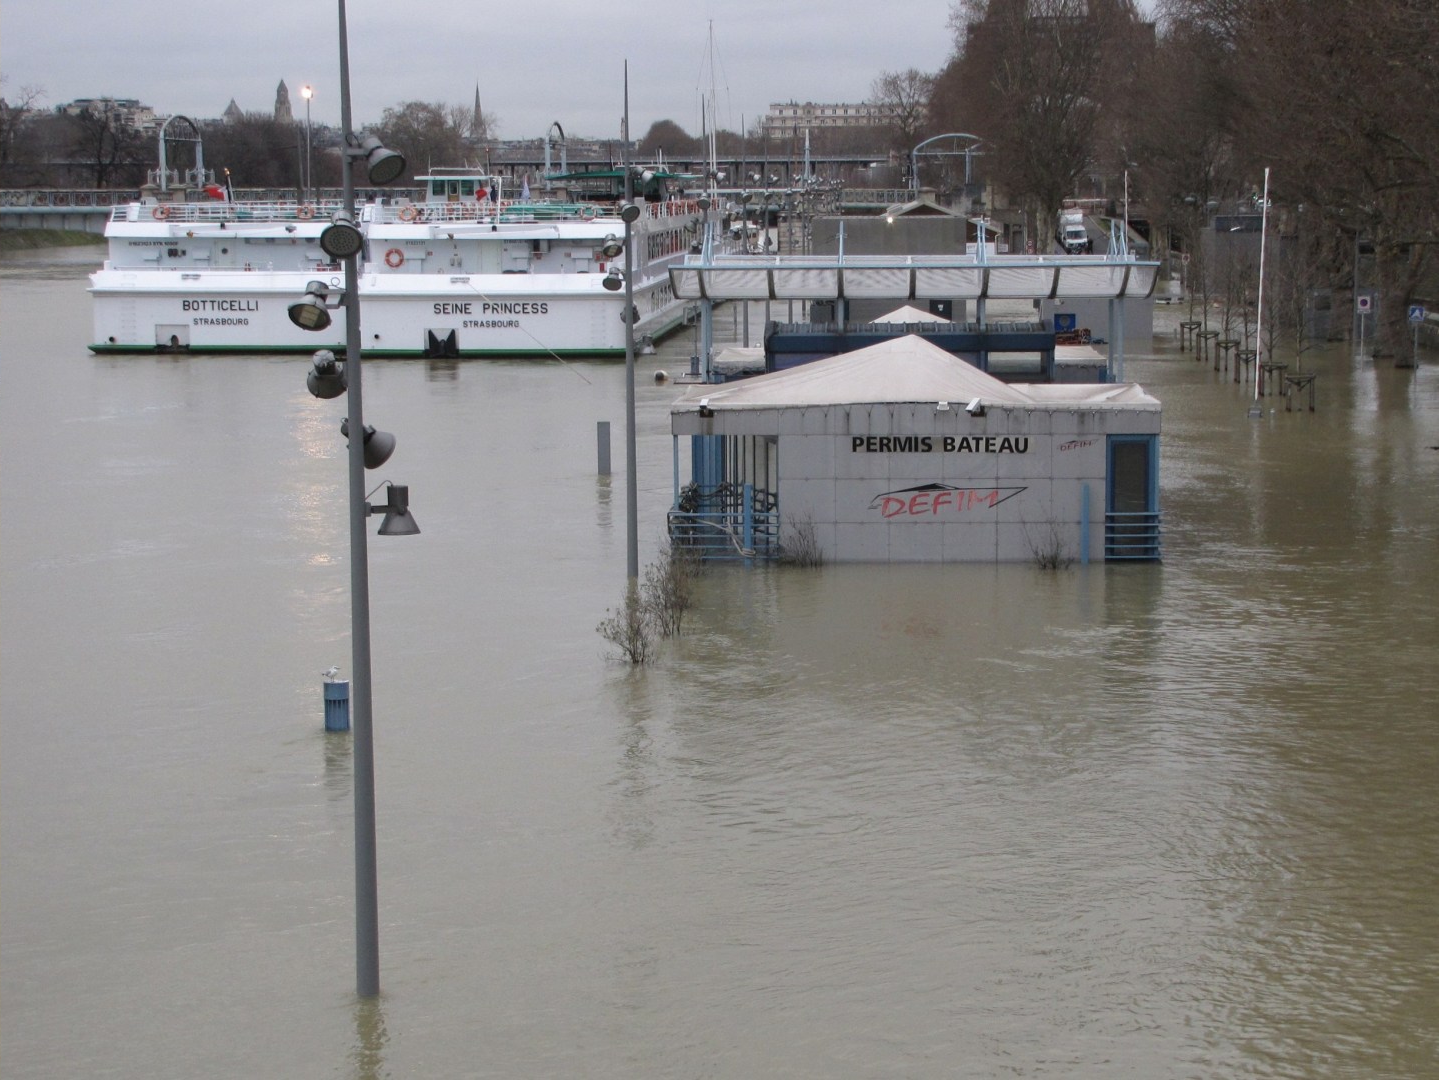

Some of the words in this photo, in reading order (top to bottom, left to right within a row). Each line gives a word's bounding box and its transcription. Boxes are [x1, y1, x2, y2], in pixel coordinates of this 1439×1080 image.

[182, 300, 259, 311] BOTTICELLI
[433, 303, 472, 315] SEINE
[482, 303, 549, 315] PRINCESS
[193, 317, 249, 327] STRASBOURG
[462, 320, 520, 329] STRASBOURG
[851, 435, 933, 453] PERMIS
[943, 436, 1029, 454] BATEAU
[880, 488, 999, 519] DEFIM
